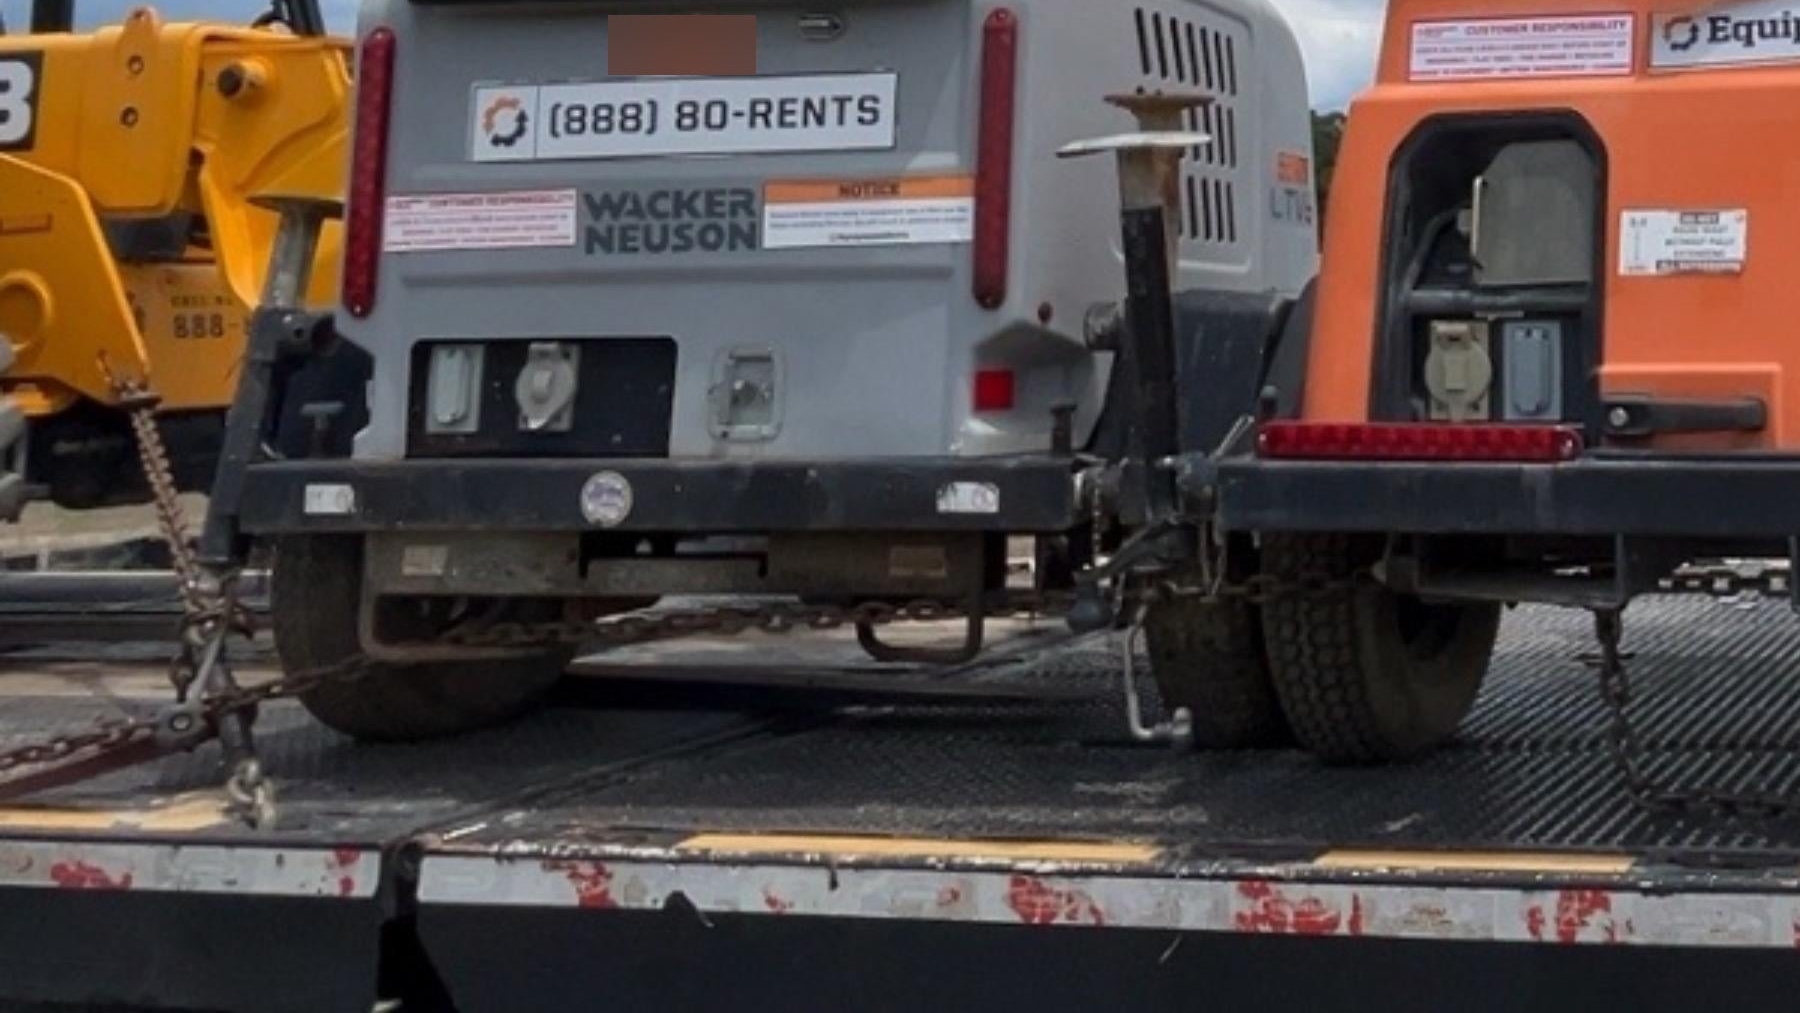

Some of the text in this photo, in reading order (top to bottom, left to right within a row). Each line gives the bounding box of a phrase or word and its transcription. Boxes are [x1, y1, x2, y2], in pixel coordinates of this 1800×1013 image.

[550, 94, 882, 138] (888) 80-RENTS
[583, 189, 757, 222] WACKER
[838, 182, 901, 198] NOTICE
[584, 221, 758, 255] NEUSON
